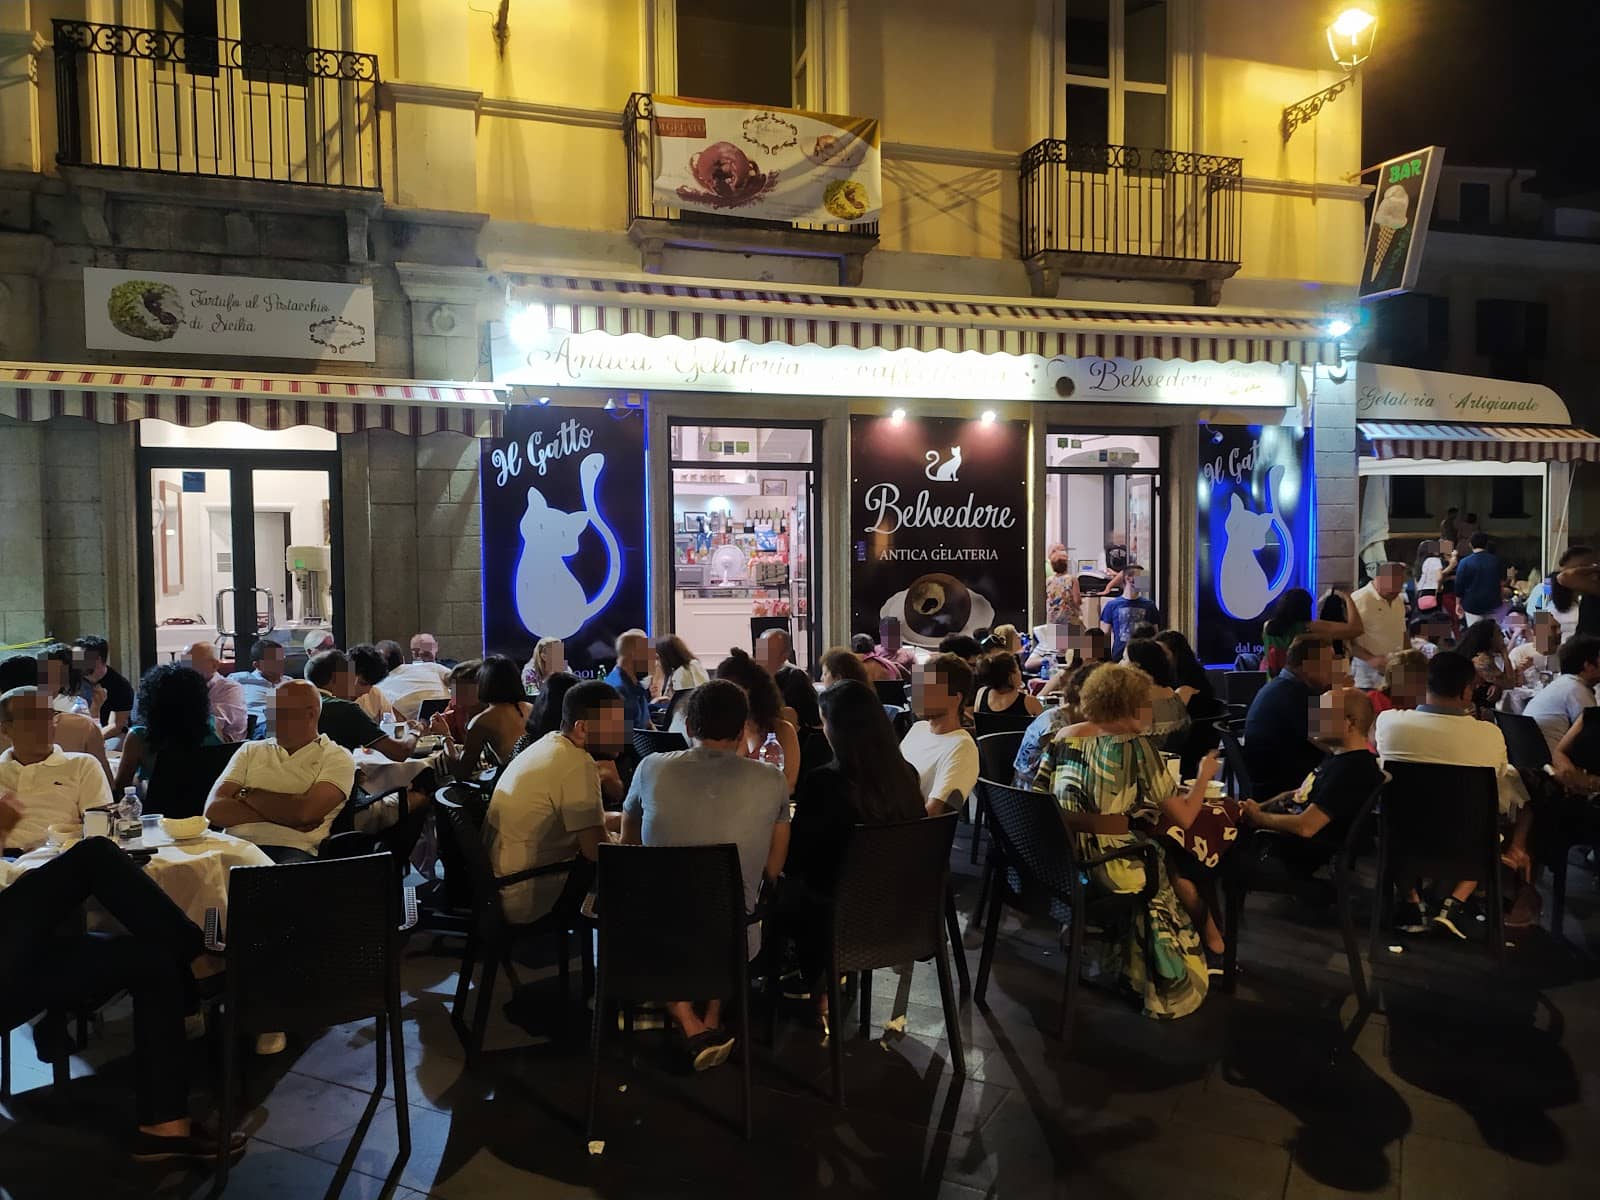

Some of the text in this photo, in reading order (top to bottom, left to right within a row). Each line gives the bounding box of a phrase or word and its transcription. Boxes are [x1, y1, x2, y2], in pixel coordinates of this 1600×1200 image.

[1389, 158, 1422, 183] BAR
[190, 288, 329, 313] Tartufo al Pistacchio
[189, 313, 256, 333] di Sicilia
[526, 336, 652, 379] Antica
[666, 345, 800, 383] Gelateria
[1089, 360, 1214, 392] Belvedere
[1357, 385, 1540, 413] Gelateria Artigianale
[527, 418, 594, 476] Gatto
[1228, 439, 1272, 485] Gat
[864, 482, 1016, 535] Belvedere
[879, 549, 928, 561] ANTICA
[931, 549, 998, 561] GELATERIA
[1235, 642, 1250, 653] dal
